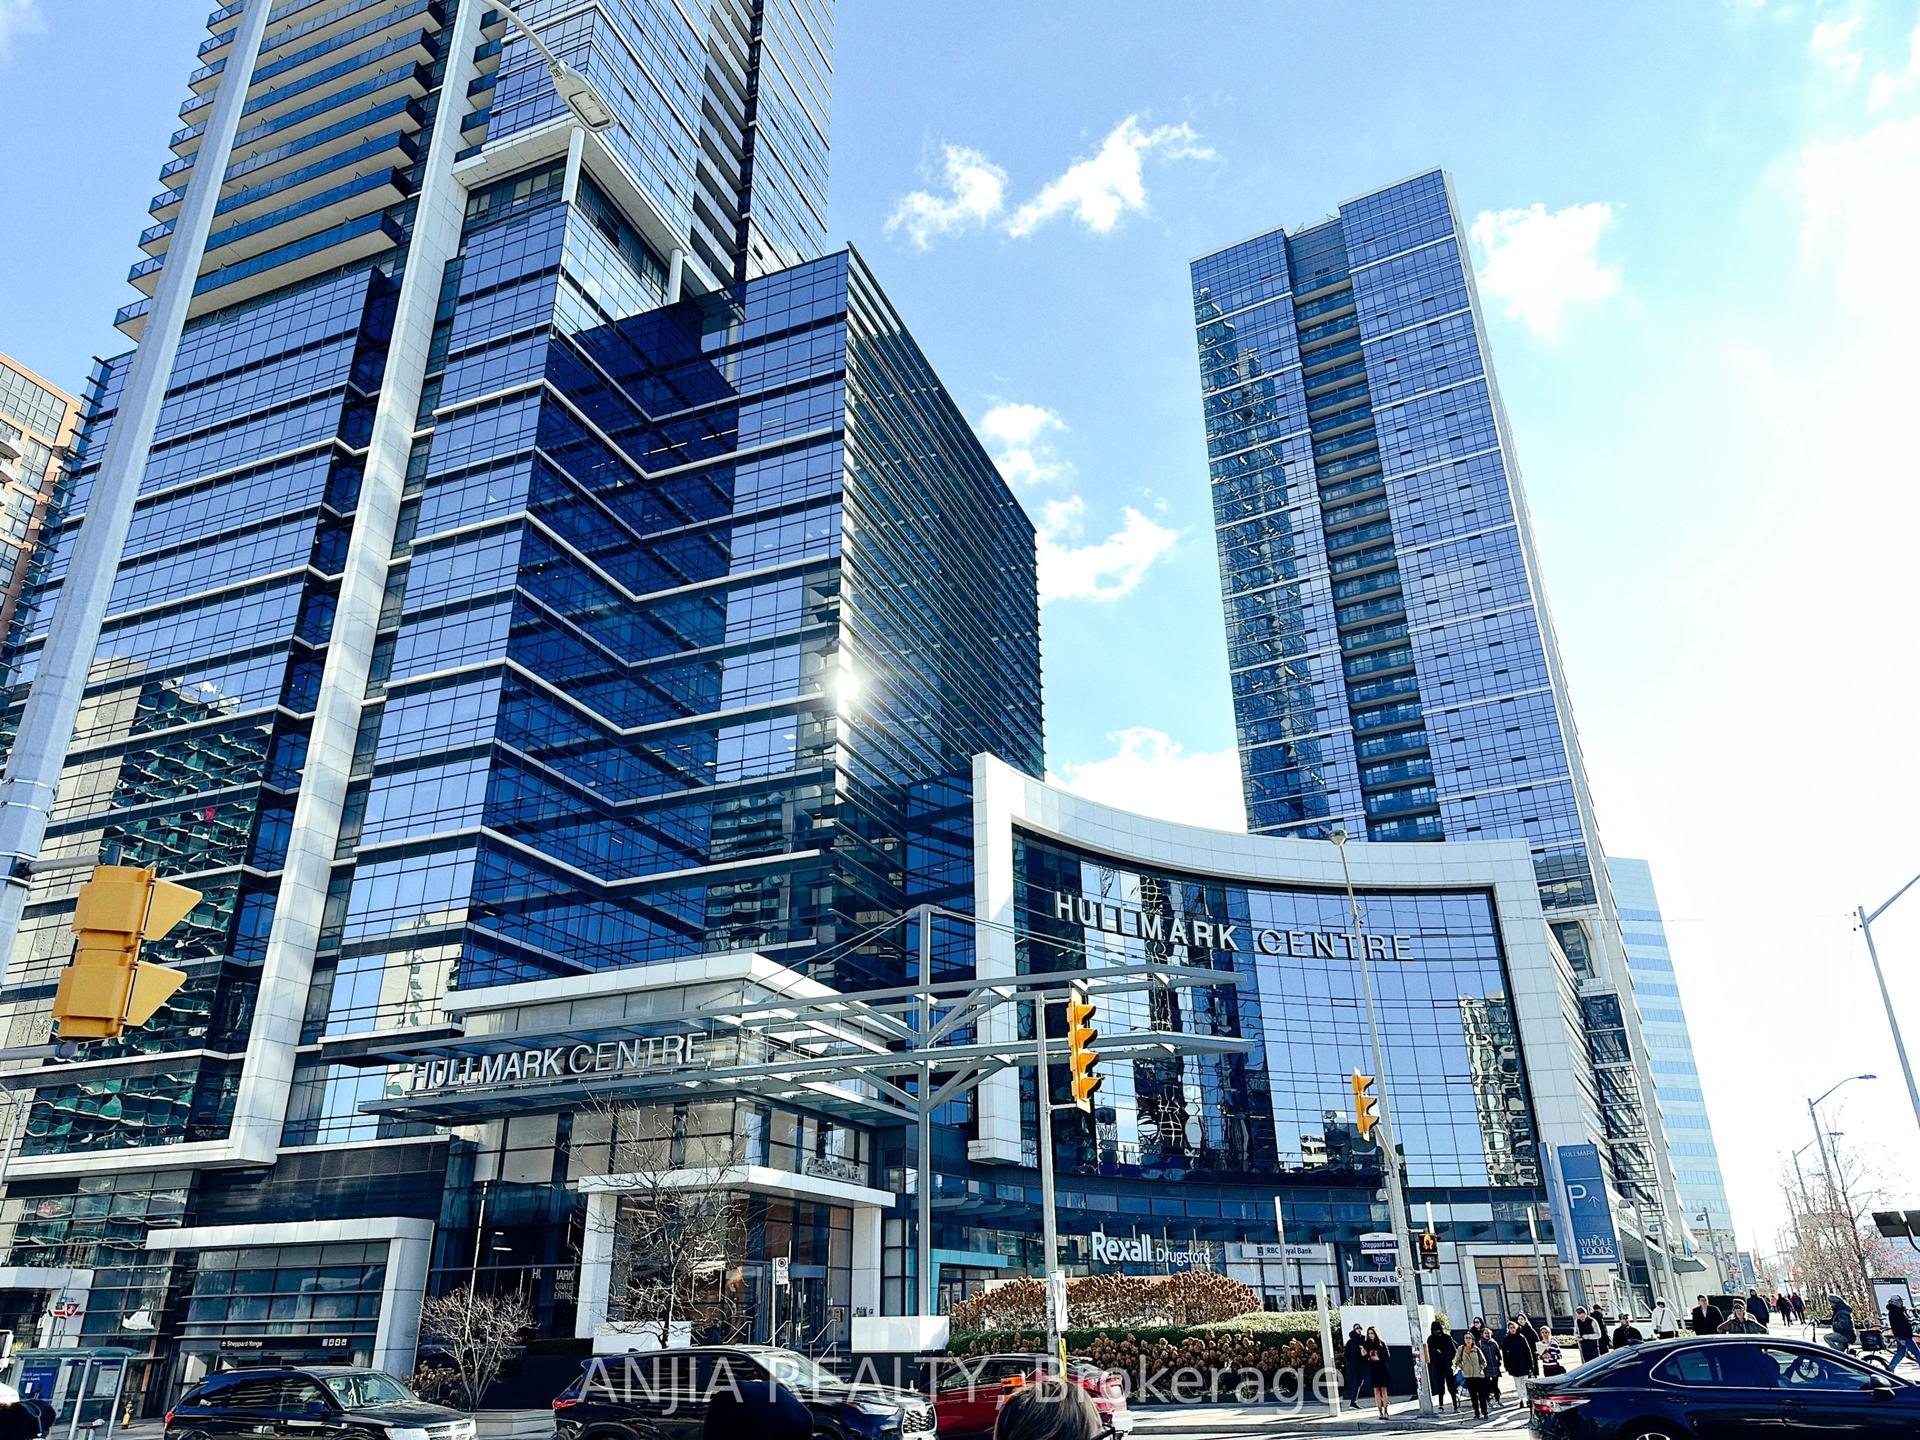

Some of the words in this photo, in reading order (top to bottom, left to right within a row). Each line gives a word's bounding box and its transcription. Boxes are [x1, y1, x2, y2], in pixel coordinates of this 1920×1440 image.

[1055, 891, 1240, 952] HULLMARK
[1257, 929, 1415, 961] CENTRE
[408, 1046, 565, 1090] HULLMARK
[568, 1031, 708, 1074] CENTRE
[1560, 1150, 1596, 1158] HULLMARK
[1567, 1184, 1587, 1209] P
[1361, 1241, 1385, 1249] Sheppard
[1578, 1237, 1614, 1247] WHOLE
[1091, 1231, 1153, 1265] Rexall
[1156, 1247, 1211, 1266] Drugstore
[1297, 1247, 1313, 1255] Bank
[1581, 1246, 1614, 1255] FOODS
[1353, 1275, 1367, 1283] RBC
[1369, 1275, 1389, 1284] Royal
